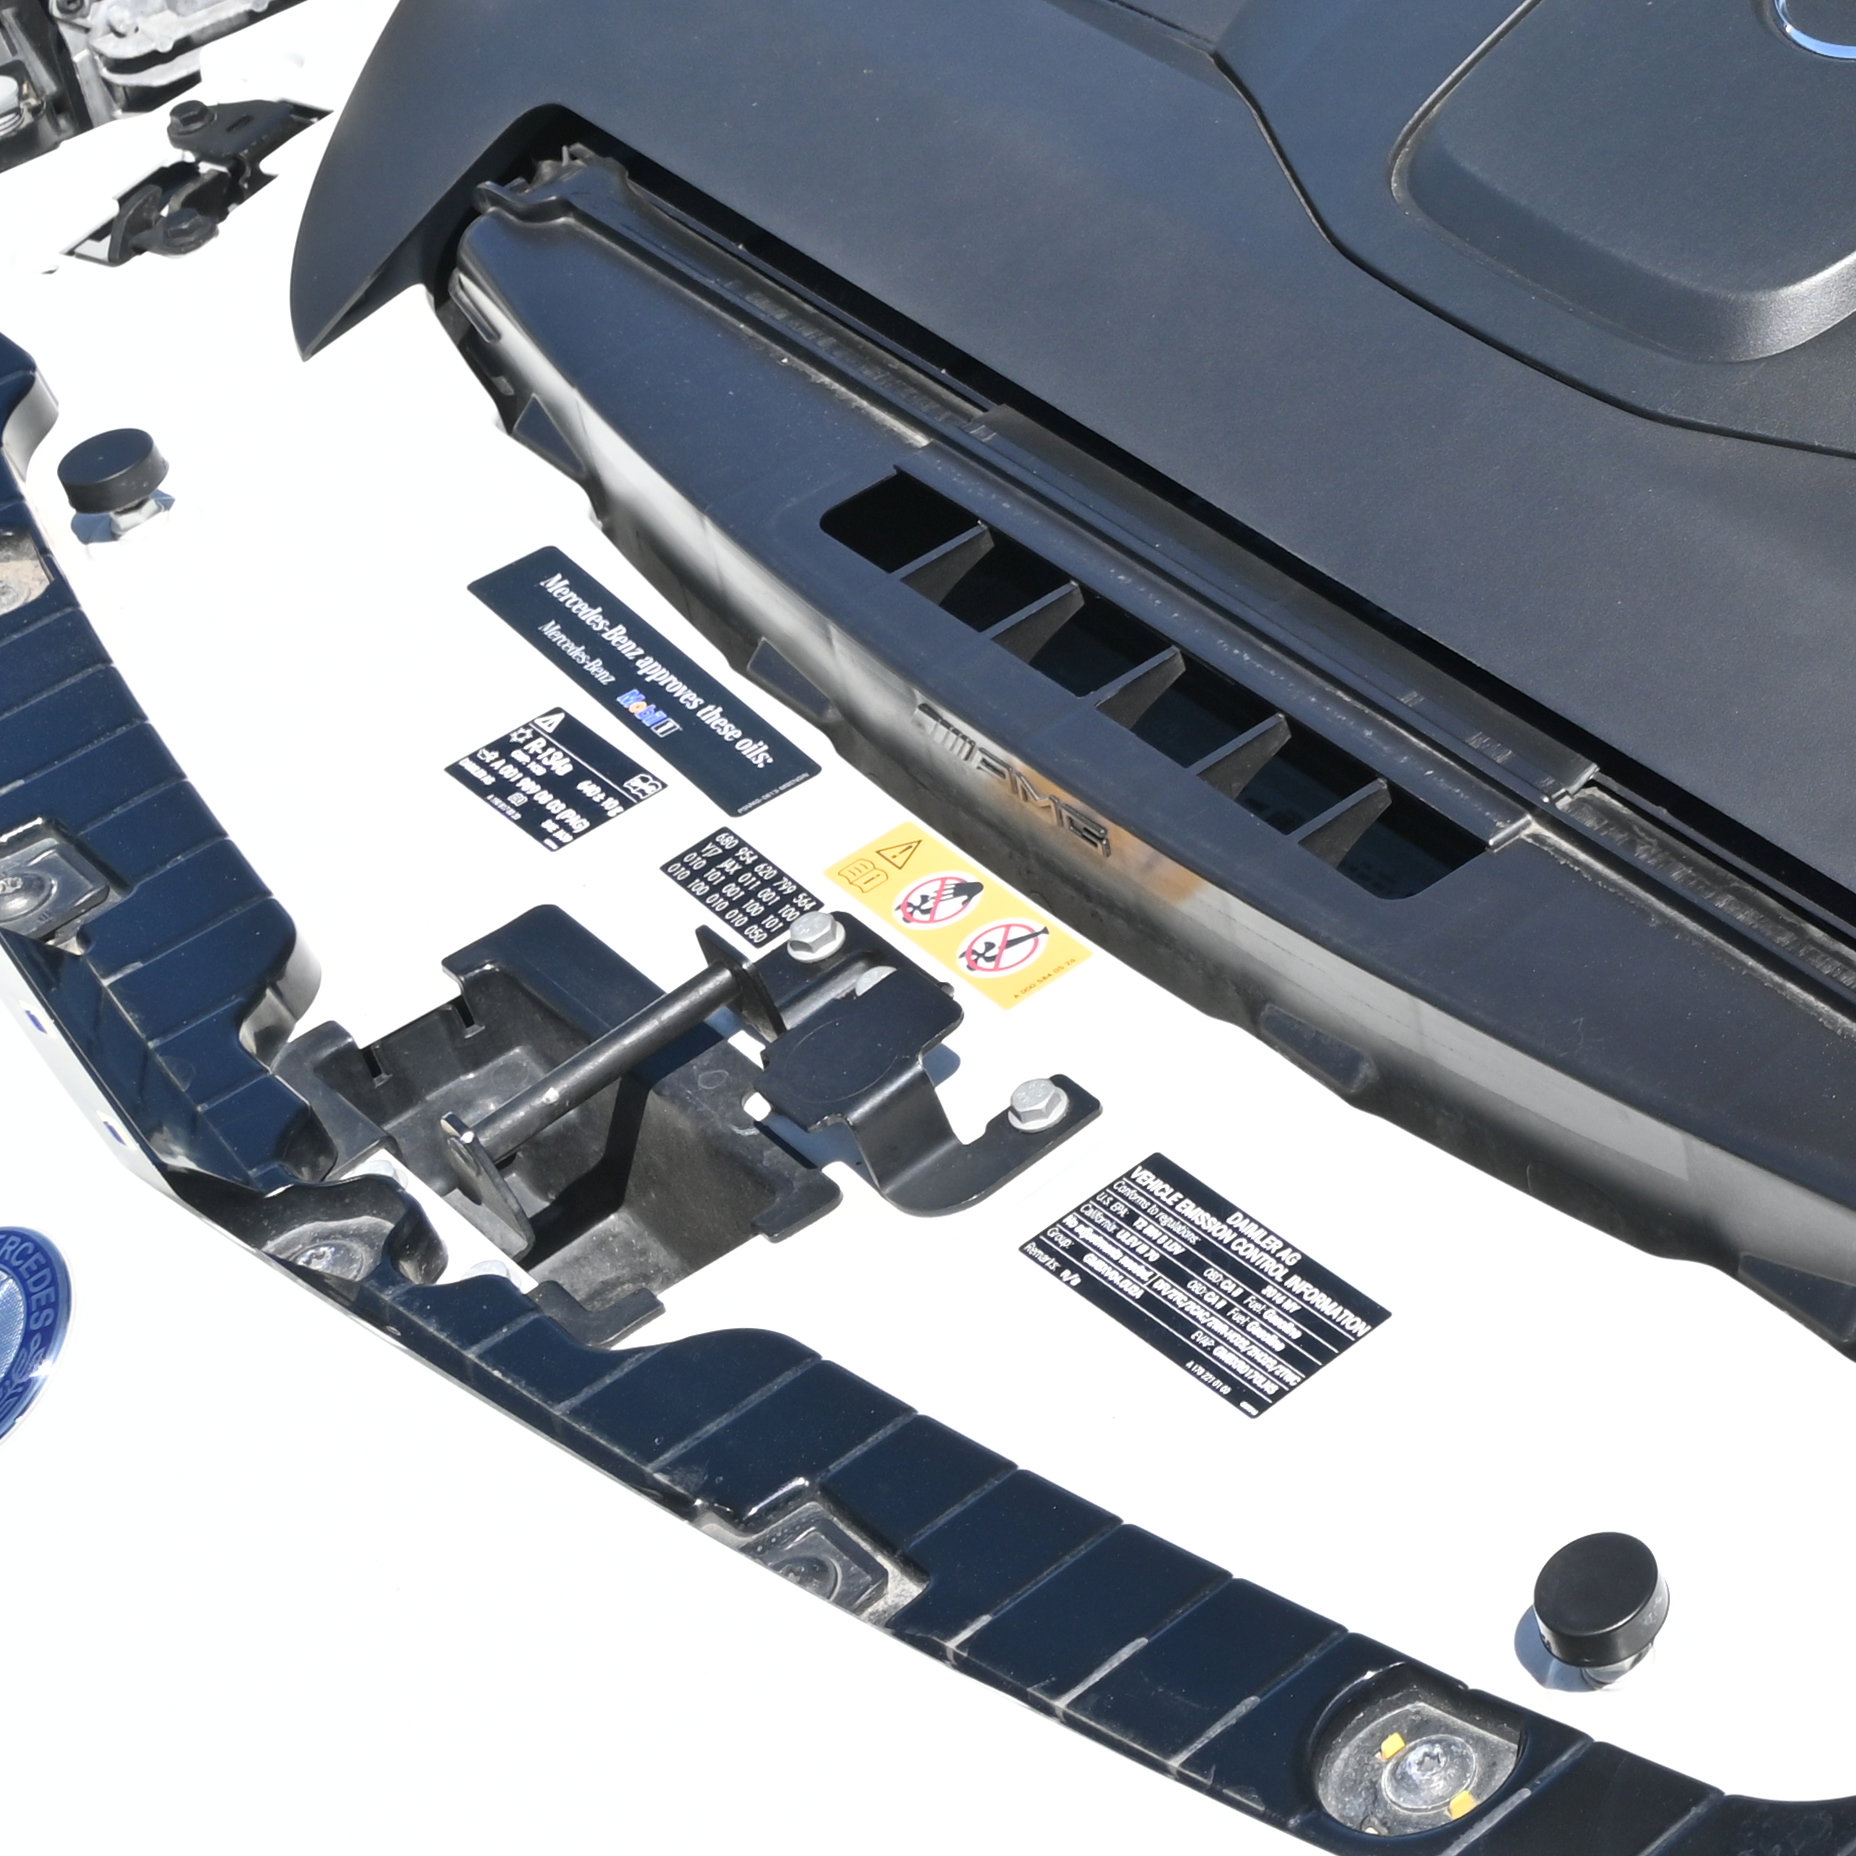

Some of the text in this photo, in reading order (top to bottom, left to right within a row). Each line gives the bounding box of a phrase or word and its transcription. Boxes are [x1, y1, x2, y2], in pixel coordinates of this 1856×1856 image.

[538, 620, 616, 685] Mercedes-Benz
[613, 687, 669, 728] Mobil
[539, 573, 773, 768] Mercedes-Benz approves these oils:
[523, 737, 573, 776] R-134a
[490, 759, 506, 770] A
[555, 809, 590, 833] (PAG)
[667, 862, 768, 943] 010 100 010 010 050
[683, 852, 784, 932] 010 101 001 100 101
[715, 832, 817, 911] 680 954 620 799 564
[738, 872, 761, 890] 011
[757, 887, 780, 906] 001
[778, 904, 800, 922] 100
[1047, 1227, 1074, 1249] Group:
[1113, 1180, 1151, 1209] Conforms
[1147, 1204, 1159, 1215] to
[1155, 1212, 1201, 1245] regulations:
[1226, 1211, 1302, 1266] DAIMLER AG
[0, 1235, 56, 1331] RCEDES
[1130, 1165, 1372, 1337] VEHICLE EMISSION CONTROL INFORMATION
[1226, 1307, 1250, 1326] Fuel:
[1243, 1295, 1266, 1314] Fuel:
